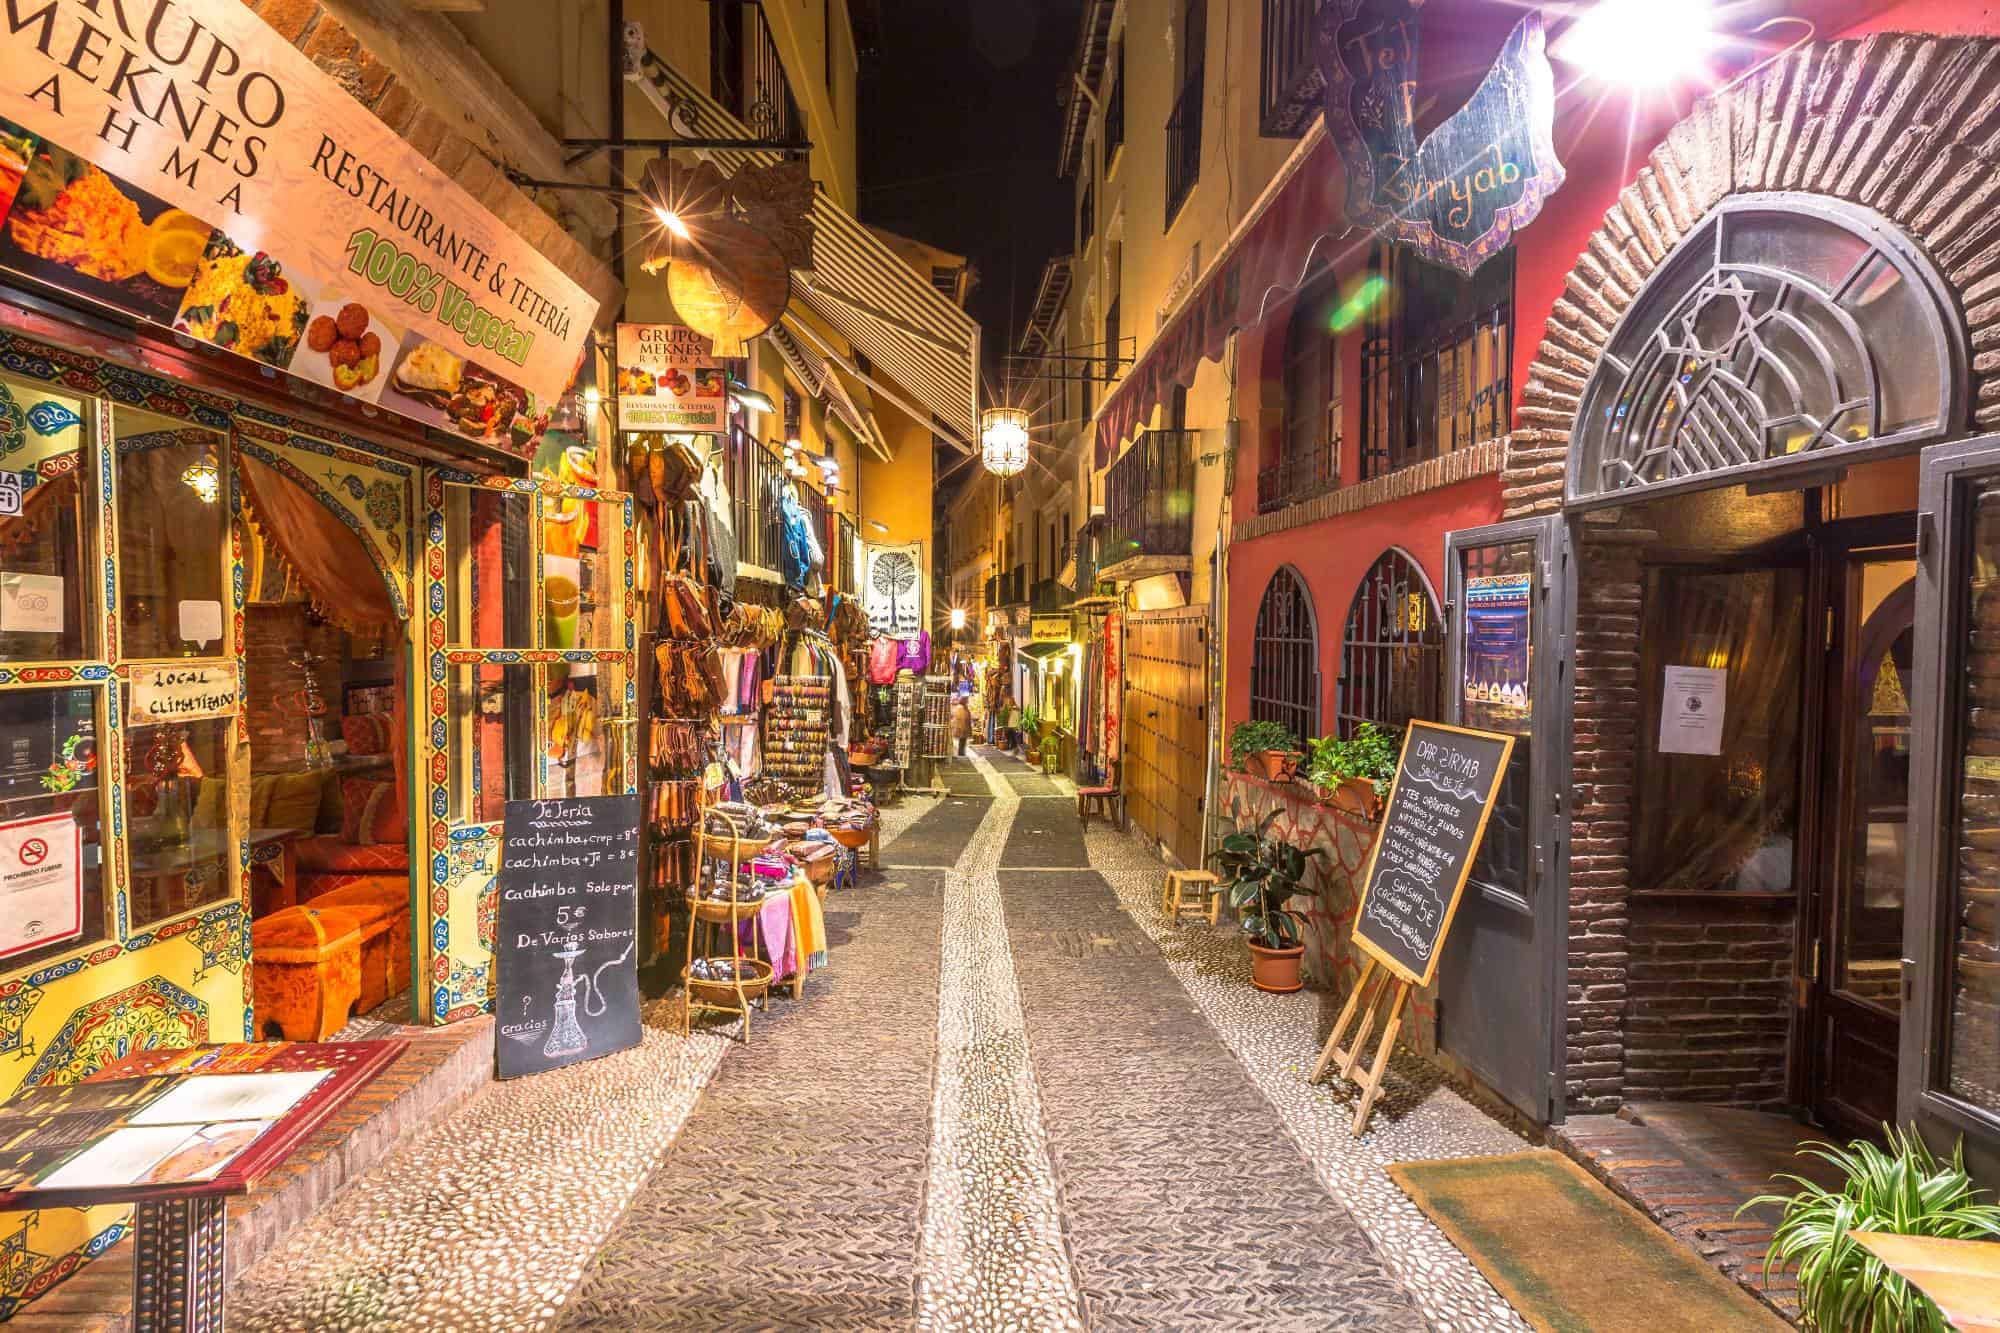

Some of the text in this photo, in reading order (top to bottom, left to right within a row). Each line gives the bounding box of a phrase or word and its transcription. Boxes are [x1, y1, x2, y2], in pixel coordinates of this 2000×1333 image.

[309, 133, 571, 341] RESTAURANTE & TETERÍA
[345, 227, 536, 367] 100% Vegetal
[638, 328, 702, 343] GRUPO
[639, 343, 702, 355] MEKNES
[639, 356, 702, 364] RAHMA
[153, 672, 209, 687] LOCAL
[539, 931, 585, 946] Varios
[501, 1018, 548, 1035] Gracias
